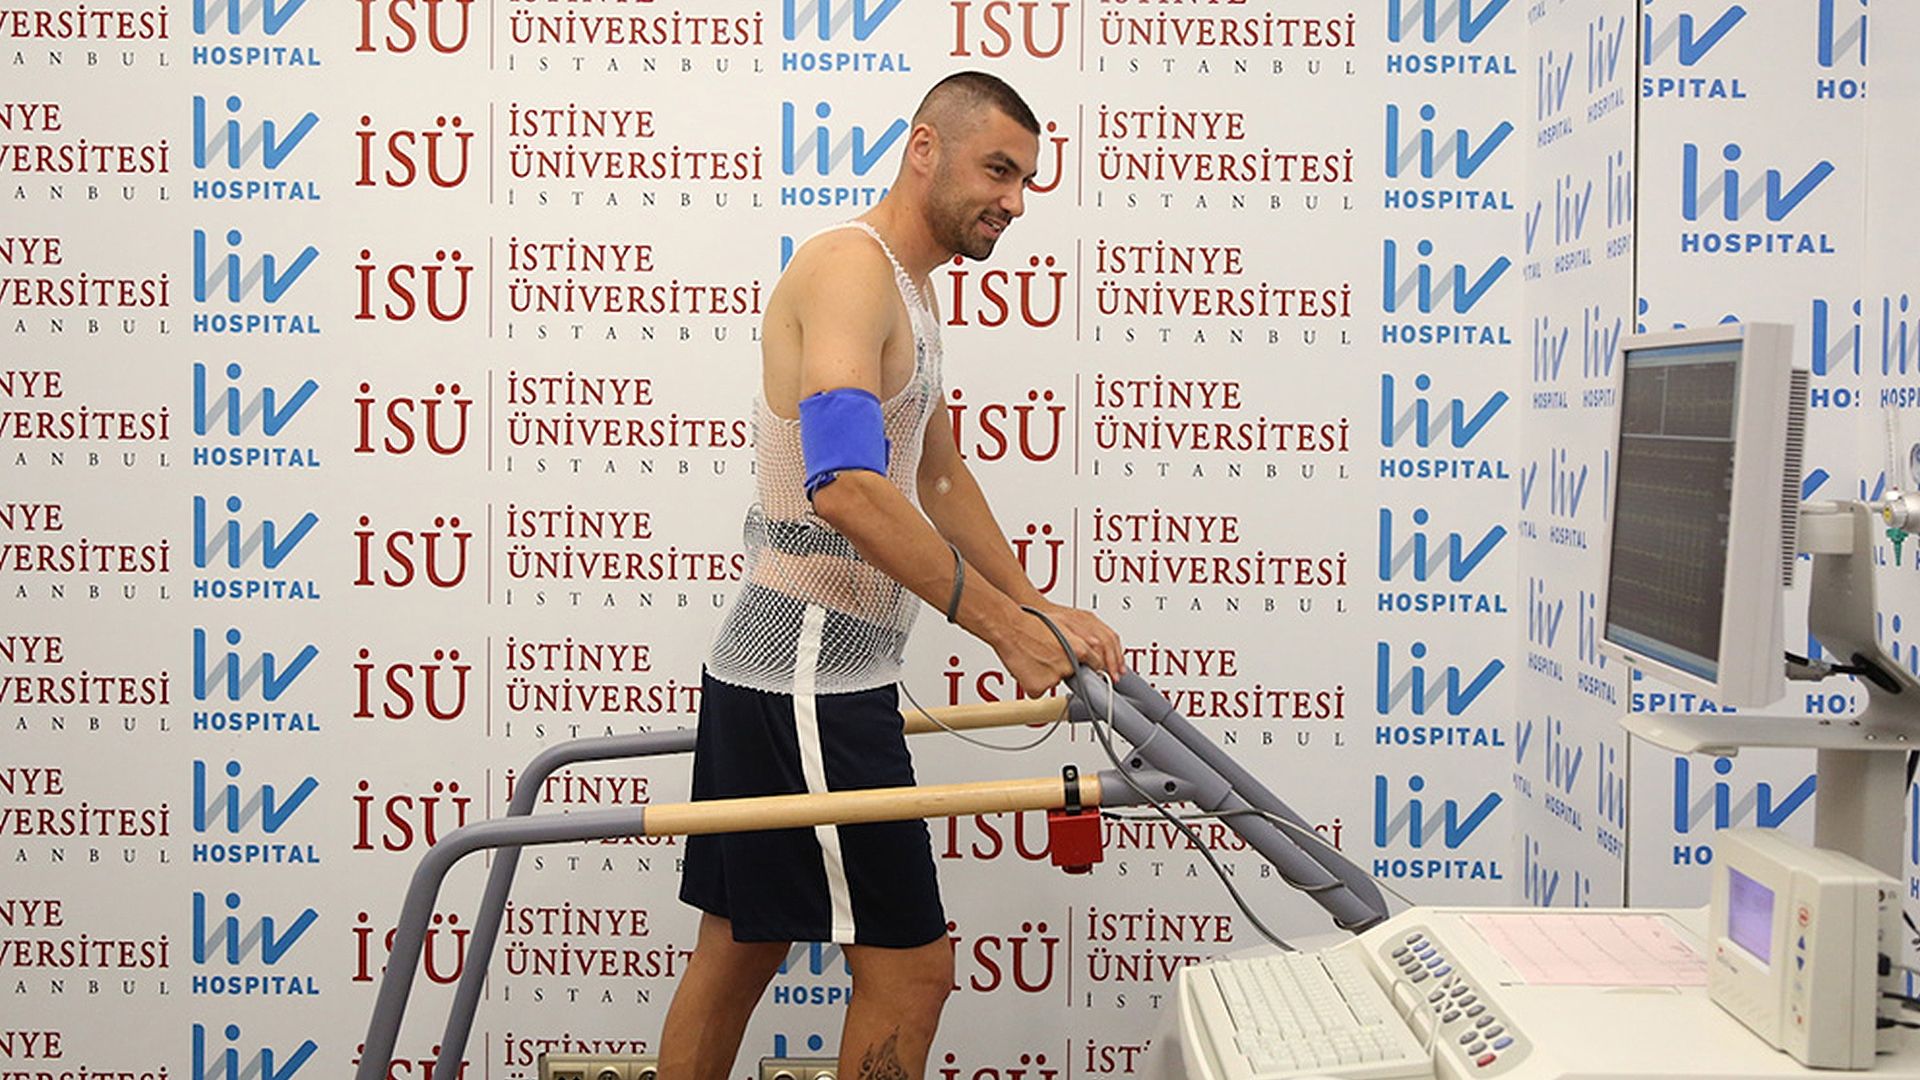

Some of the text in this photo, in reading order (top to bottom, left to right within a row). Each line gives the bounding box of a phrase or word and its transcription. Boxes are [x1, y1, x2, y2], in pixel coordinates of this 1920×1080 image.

[509, 9, 763, 48] ÜNİVERSİTESİ
[1100, 10, 1356, 48] ÜNİVERSİTESİ
[193, 46, 321, 66] HOSPITAL
[782, 51, 911, 72] HOSPITAL
[1387, 52, 1517, 76] HOSPITAL
[193, 95, 319, 170] liv
[509, 102, 655, 139] İSTİNYE
[781, 101, 909, 177] liv
[1098, 104, 1245, 140] İSTİNYE
[355, 115, 474, 188] İSÜ
[1385, 104, 1514, 179] liv
[509, 144, 762, 180] ÜNİVERSİTESİ
[1098, 146, 1356, 183] ÜNİVERSİTESİ
[193, 180, 320, 202] HOSPITAL
[1384, 190, 1514, 210] HOSPITAL
[1683, 143, 1836, 222] liv
[509, 236, 654, 272] İSTİNYE
[1096, 239, 1243, 277] İSTİNYE
[1682, 232, 1837, 254] HOSPITAL
[193, 229, 319, 303] liv
[1383, 239, 1512, 314] liv
[354, 249, 474, 322] İSÜ
[508, 278, 764, 316] ÜNİVERSİTESİ
[946, 255, 1070, 328] İSÜ
[1096, 278, 1351, 318] ÜNİVERSİTESİ
[193, 313, 320, 336] HOSPITAL
[1382, 325, 1512, 347] HOSPITAL
[193, 363, 319, 437] liv
[508, 368, 653, 405] İSTİNYE
[1094, 373, 1241, 409] İSTİNYE
[354, 382, 473, 455] İSÜ
[1381, 374, 1509, 448] liv
[1094, 415, 1350, 452] ÜNİVERSİTESİ
[193, 447, 320, 467] HOSPITAL
[1377, 459, 1510, 480] HOSPITAL
[193, 496, 319, 569] liv
[504, 504, 652, 541] İSTİNYE
[1093, 507, 1239, 544] İSTİNYE
[354, 515, 472, 588] İSÜ
[1379, 508, 1508, 582] liv
[1093, 549, 1347, 586] ÜNİVERSİTESİ
[193, 578, 320, 601] HOSPITAL
[1378, 593, 1508, 615] HOSPITAL
[193, 628, 319, 702] liv
[506, 636, 651, 672] İSTİNYE
[353, 648, 472, 721] İSÜ
[1376, 642, 1505, 716] liv
[193, 711, 320, 733] HOSPITAL
[1376, 726, 1505, 749] HOSPITAL
[193, 760, 319, 834] liv
[505, 768, 650, 804] İTİNYE
[1374, 775, 1503, 849] liv
[192, 843, 320, 864] HOSPITAL
[1371, 859, 1503, 882] HOSPITAL
[192, 892, 319, 965] liv
[504, 898, 649, 936] İSTİNYE
[1087, 907, 1233, 942] İSTİNYE
[192, 976, 320, 995] HOSPITAL
